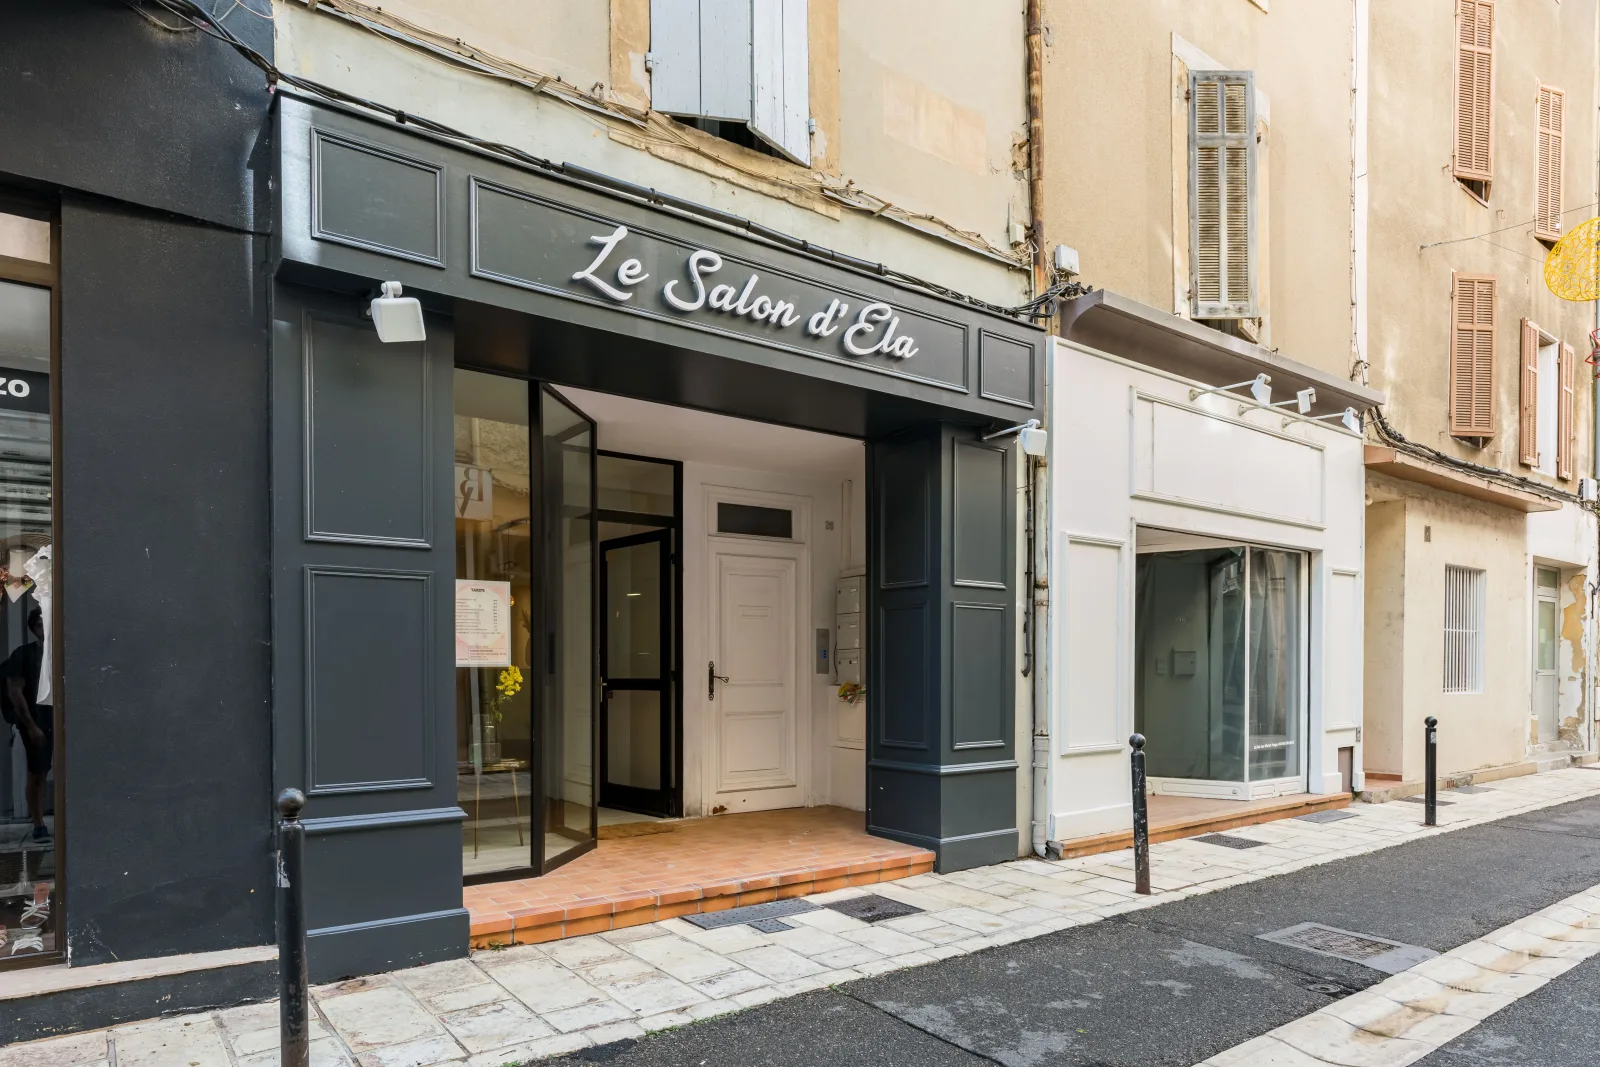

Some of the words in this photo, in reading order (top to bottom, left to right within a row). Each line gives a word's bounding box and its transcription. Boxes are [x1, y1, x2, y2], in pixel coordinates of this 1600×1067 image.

[572, 226, 649, 300] Le
[663, 249, 800, 328] Salon
[808, 298, 919, 359] d'Ela
